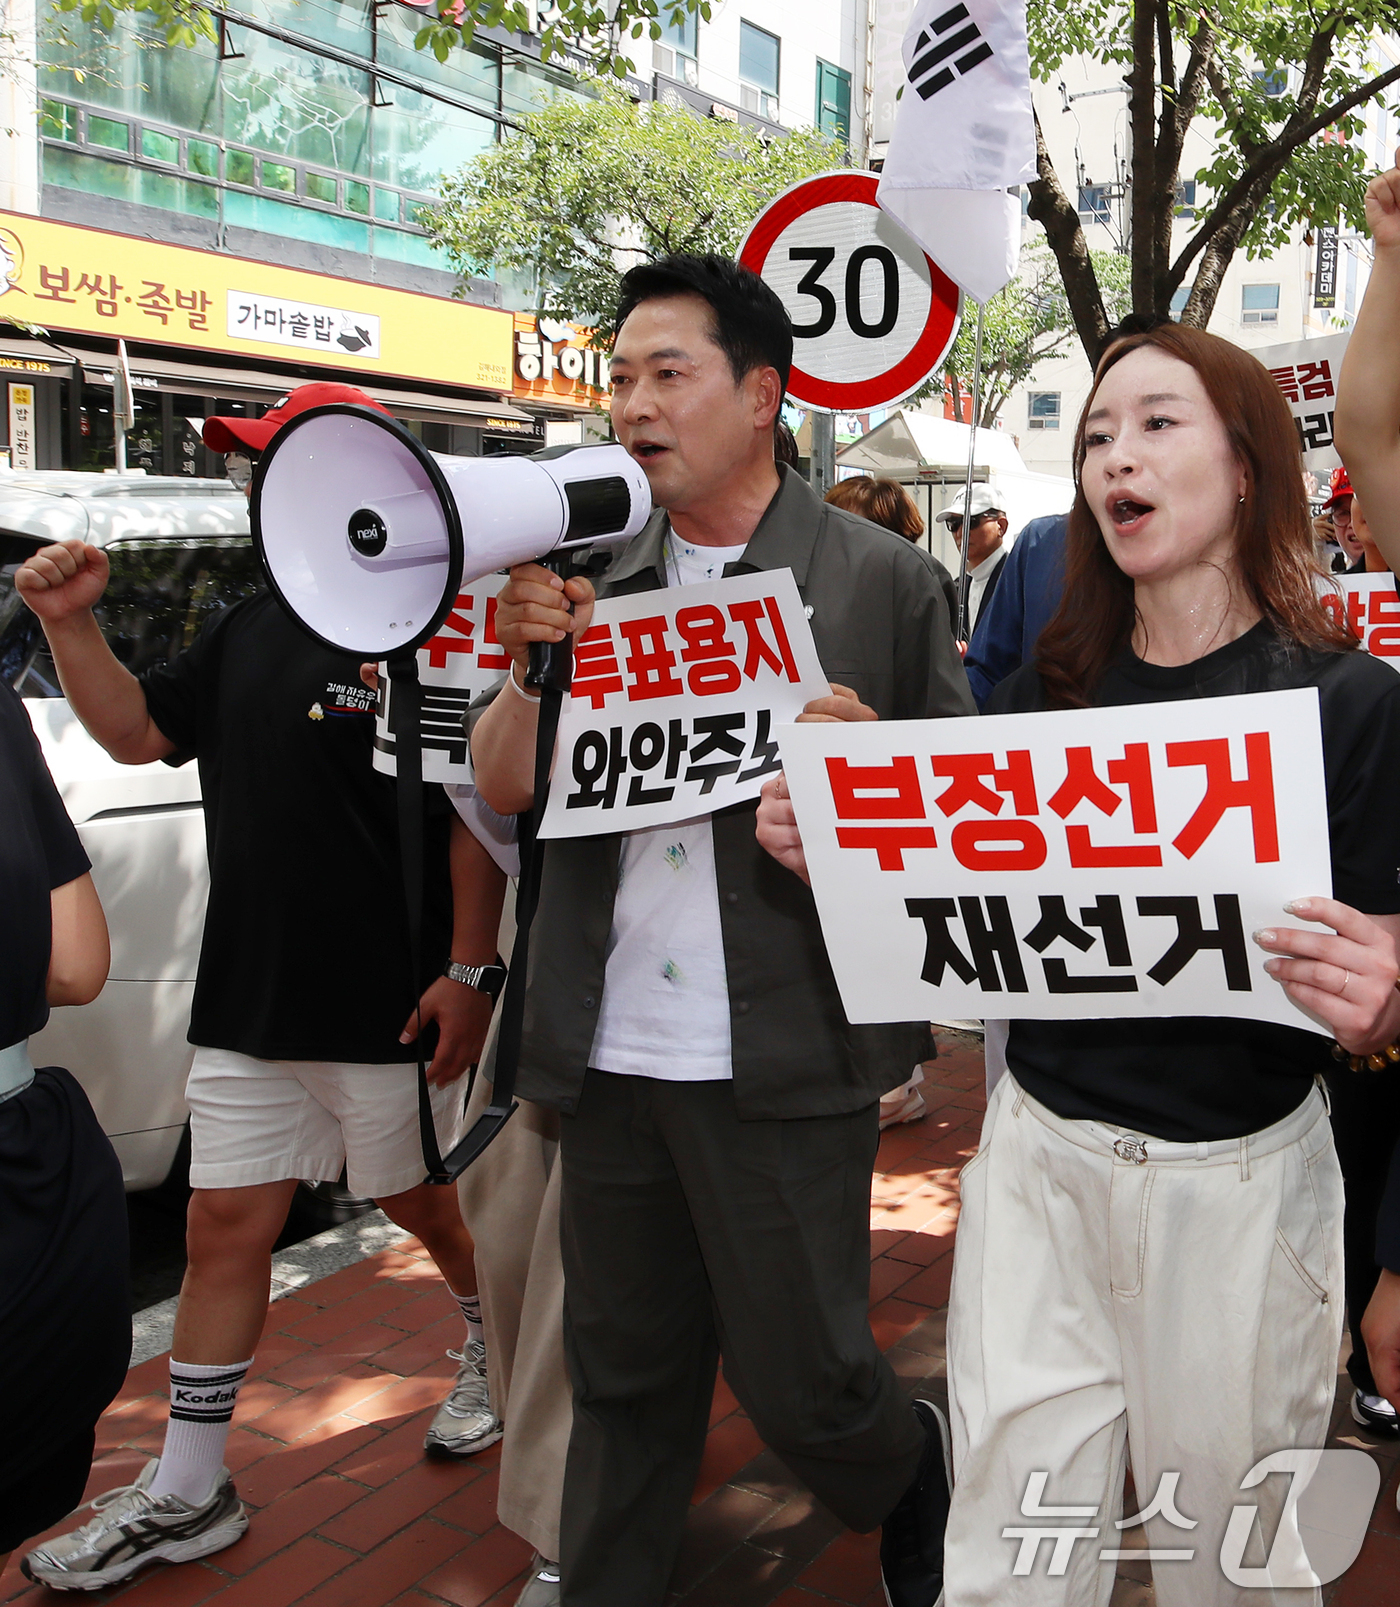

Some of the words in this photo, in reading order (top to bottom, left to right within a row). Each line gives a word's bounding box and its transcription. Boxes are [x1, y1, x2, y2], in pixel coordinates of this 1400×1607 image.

[33, 264, 214, 332] 보쌈·족발
[236, 302, 335, 343] 가마솥밥
[787, 245, 900, 339] 30
[0, 357, 24, 370] INCE
[24, 360, 51, 373] 1975
[514, 330, 610, 392] 하이
[357, 523, 378, 539] nexi
[571, 596, 801, 710] 투표용지
[346, 686, 377, 701] 자유우
[824, 731, 1280, 872] 부정선거
[904, 894, 1252, 993] 재선거
[175, 1386, 239, 1404] Kodak
